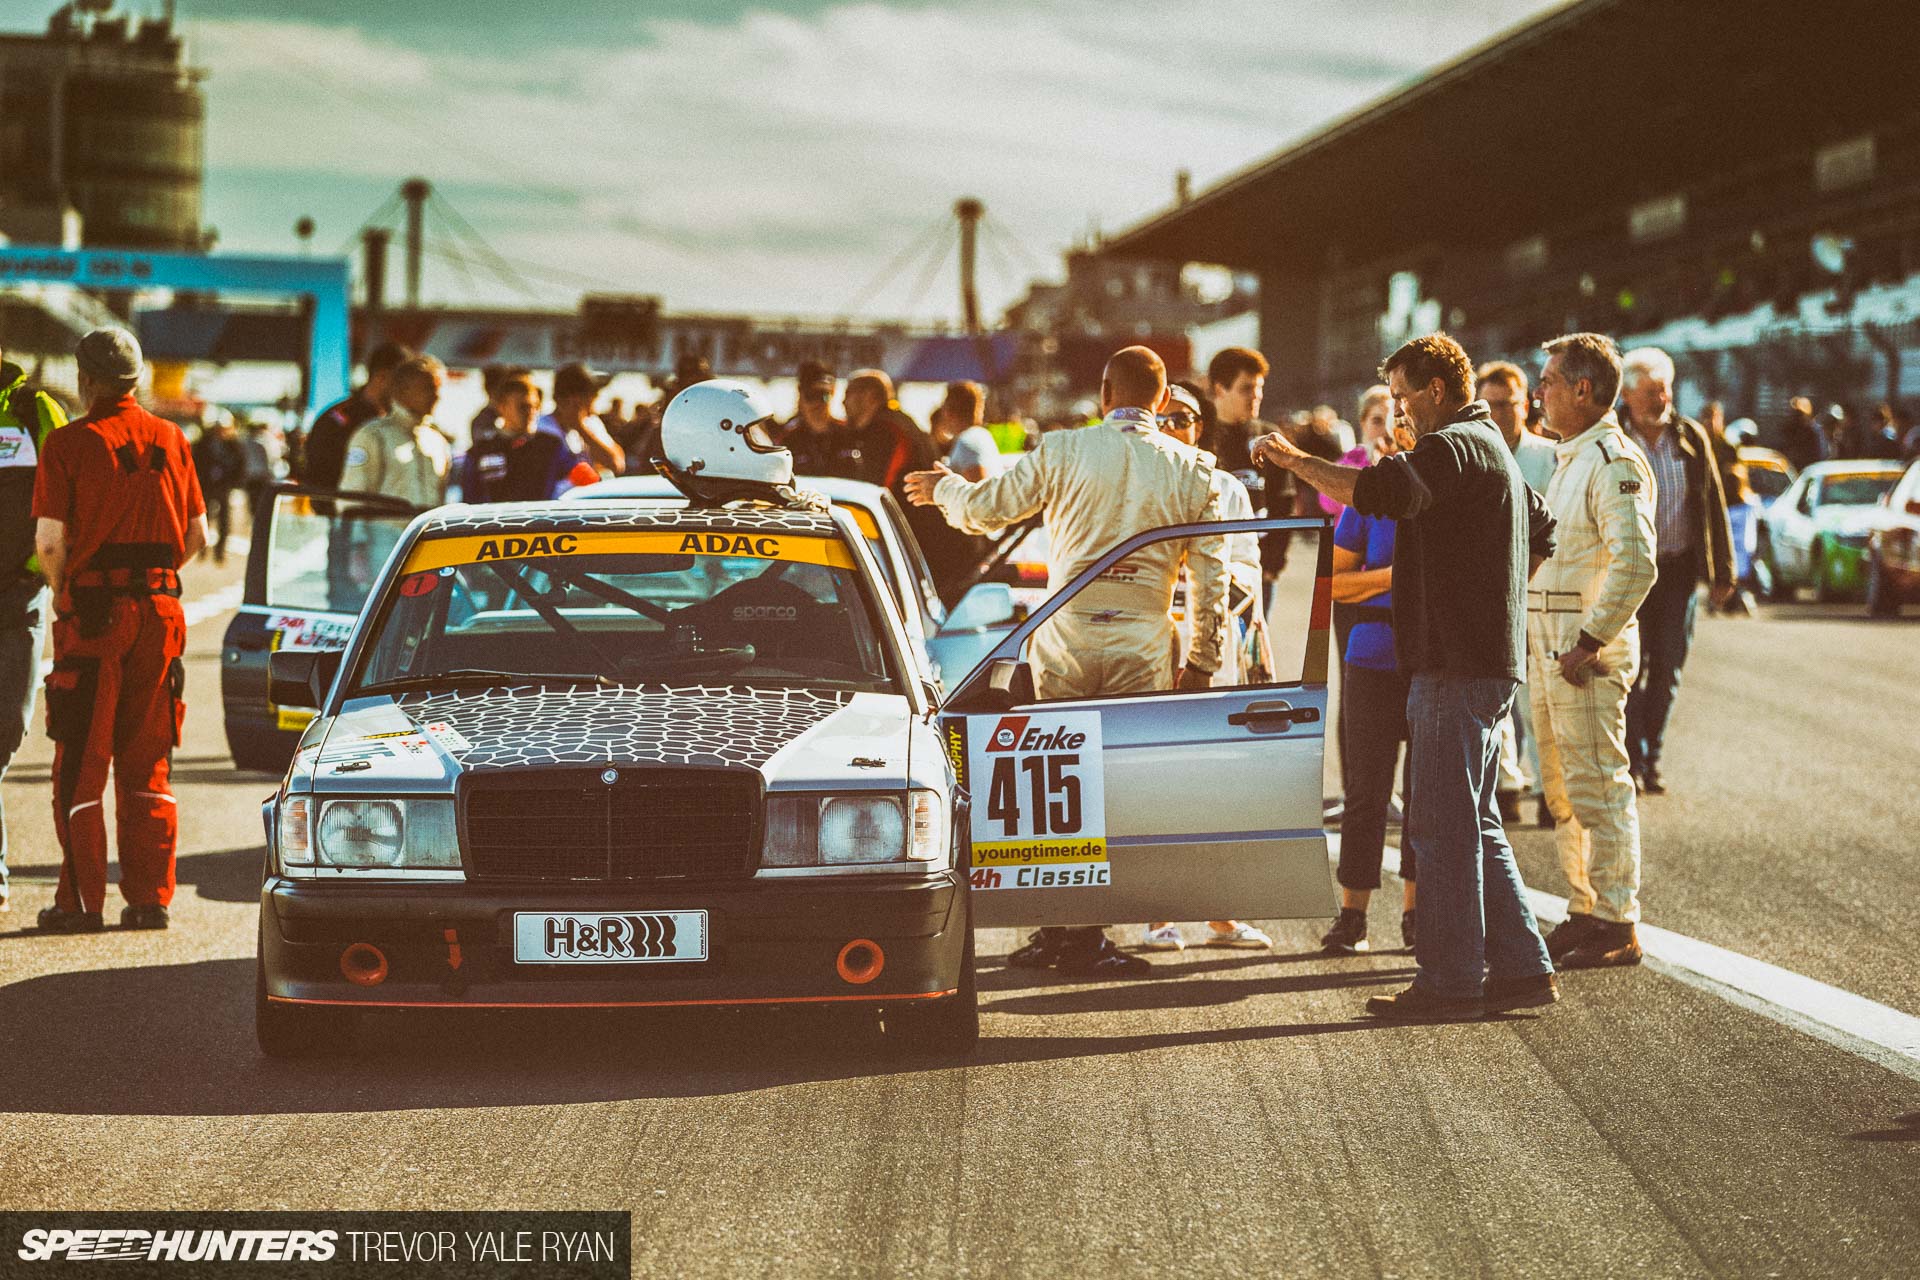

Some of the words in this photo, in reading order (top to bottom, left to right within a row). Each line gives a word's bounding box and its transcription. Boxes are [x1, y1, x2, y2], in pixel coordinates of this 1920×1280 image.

[476, 534, 578, 560] ADAC
[679, 533, 780, 558] ADAC
[732, 605, 797, 619] sparco
[1018, 726, 1086, 751] Enke
[987, 754, 1082, 836] 415
[977, 842, 1102, 863] youngtimer.de
[1016, 864, 1108, 886] Classic
[546, 919, 625, 953] H&R
